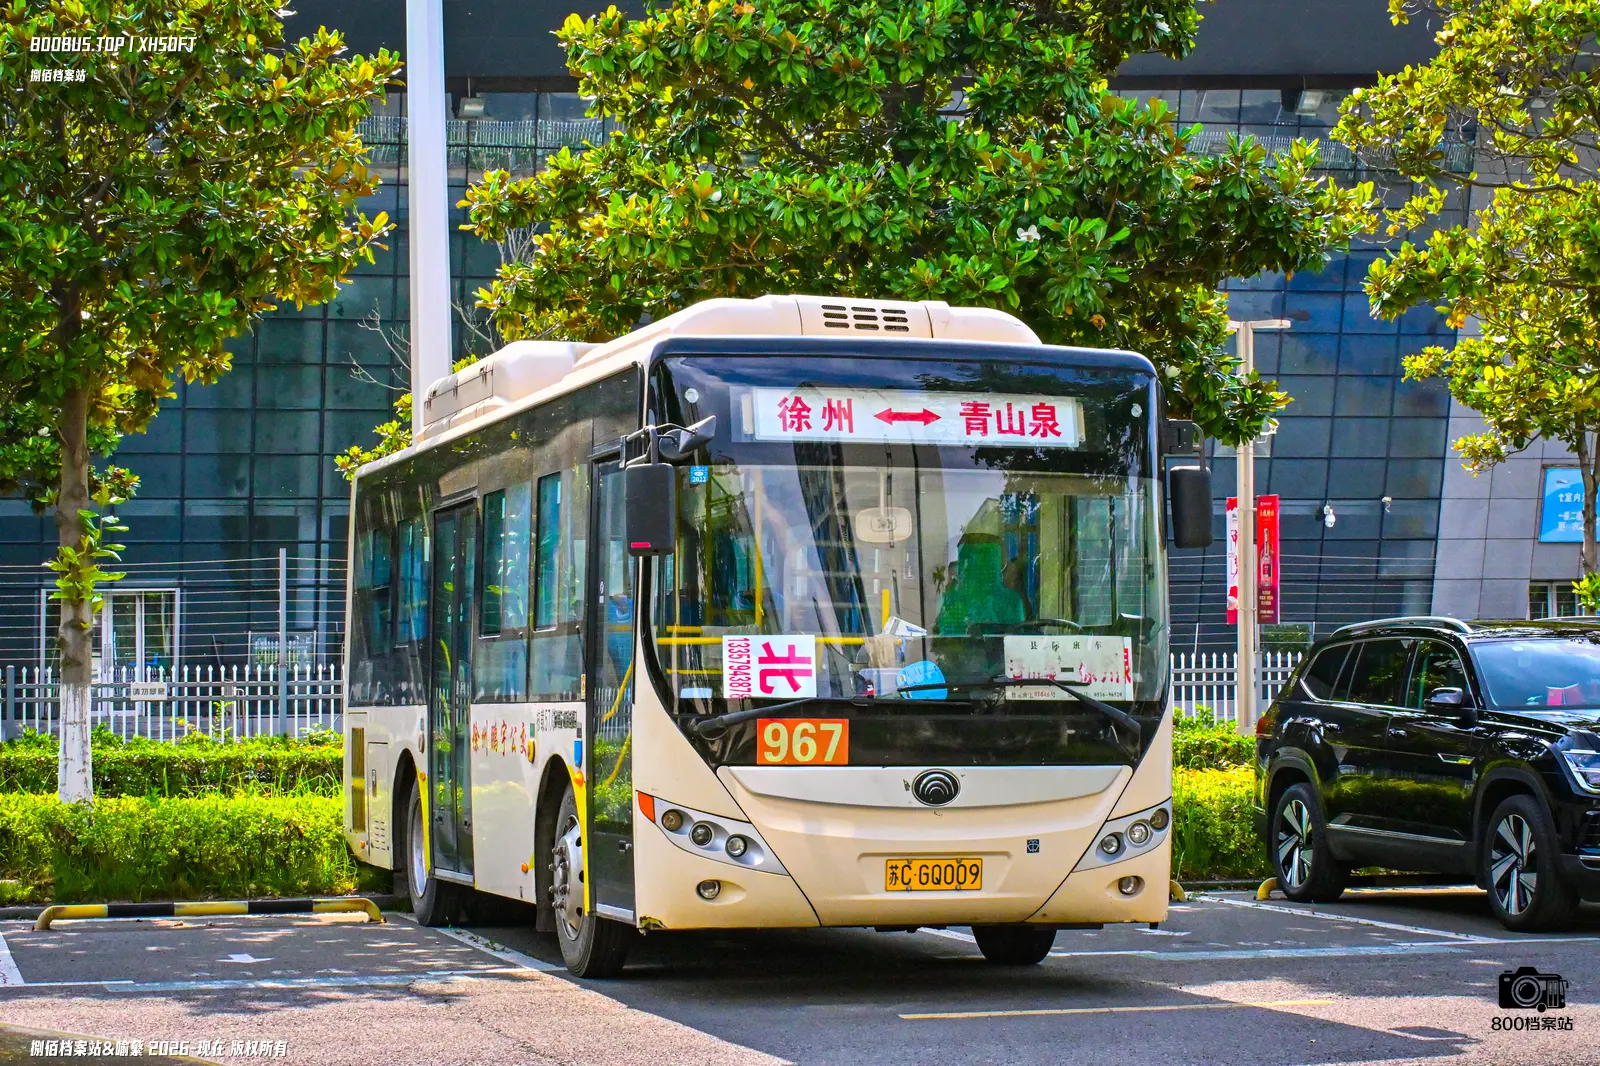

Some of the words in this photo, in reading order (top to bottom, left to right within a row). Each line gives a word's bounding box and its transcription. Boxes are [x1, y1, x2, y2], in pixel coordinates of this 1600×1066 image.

[776, 395, 855, 434] 徐州
[958, 400, 1062, 438] 青山泉
[758, 641, 813, 695] 北
[763, 722, 843, 762] 967
[888, 863, 980, 886] 苏C·GQ009
